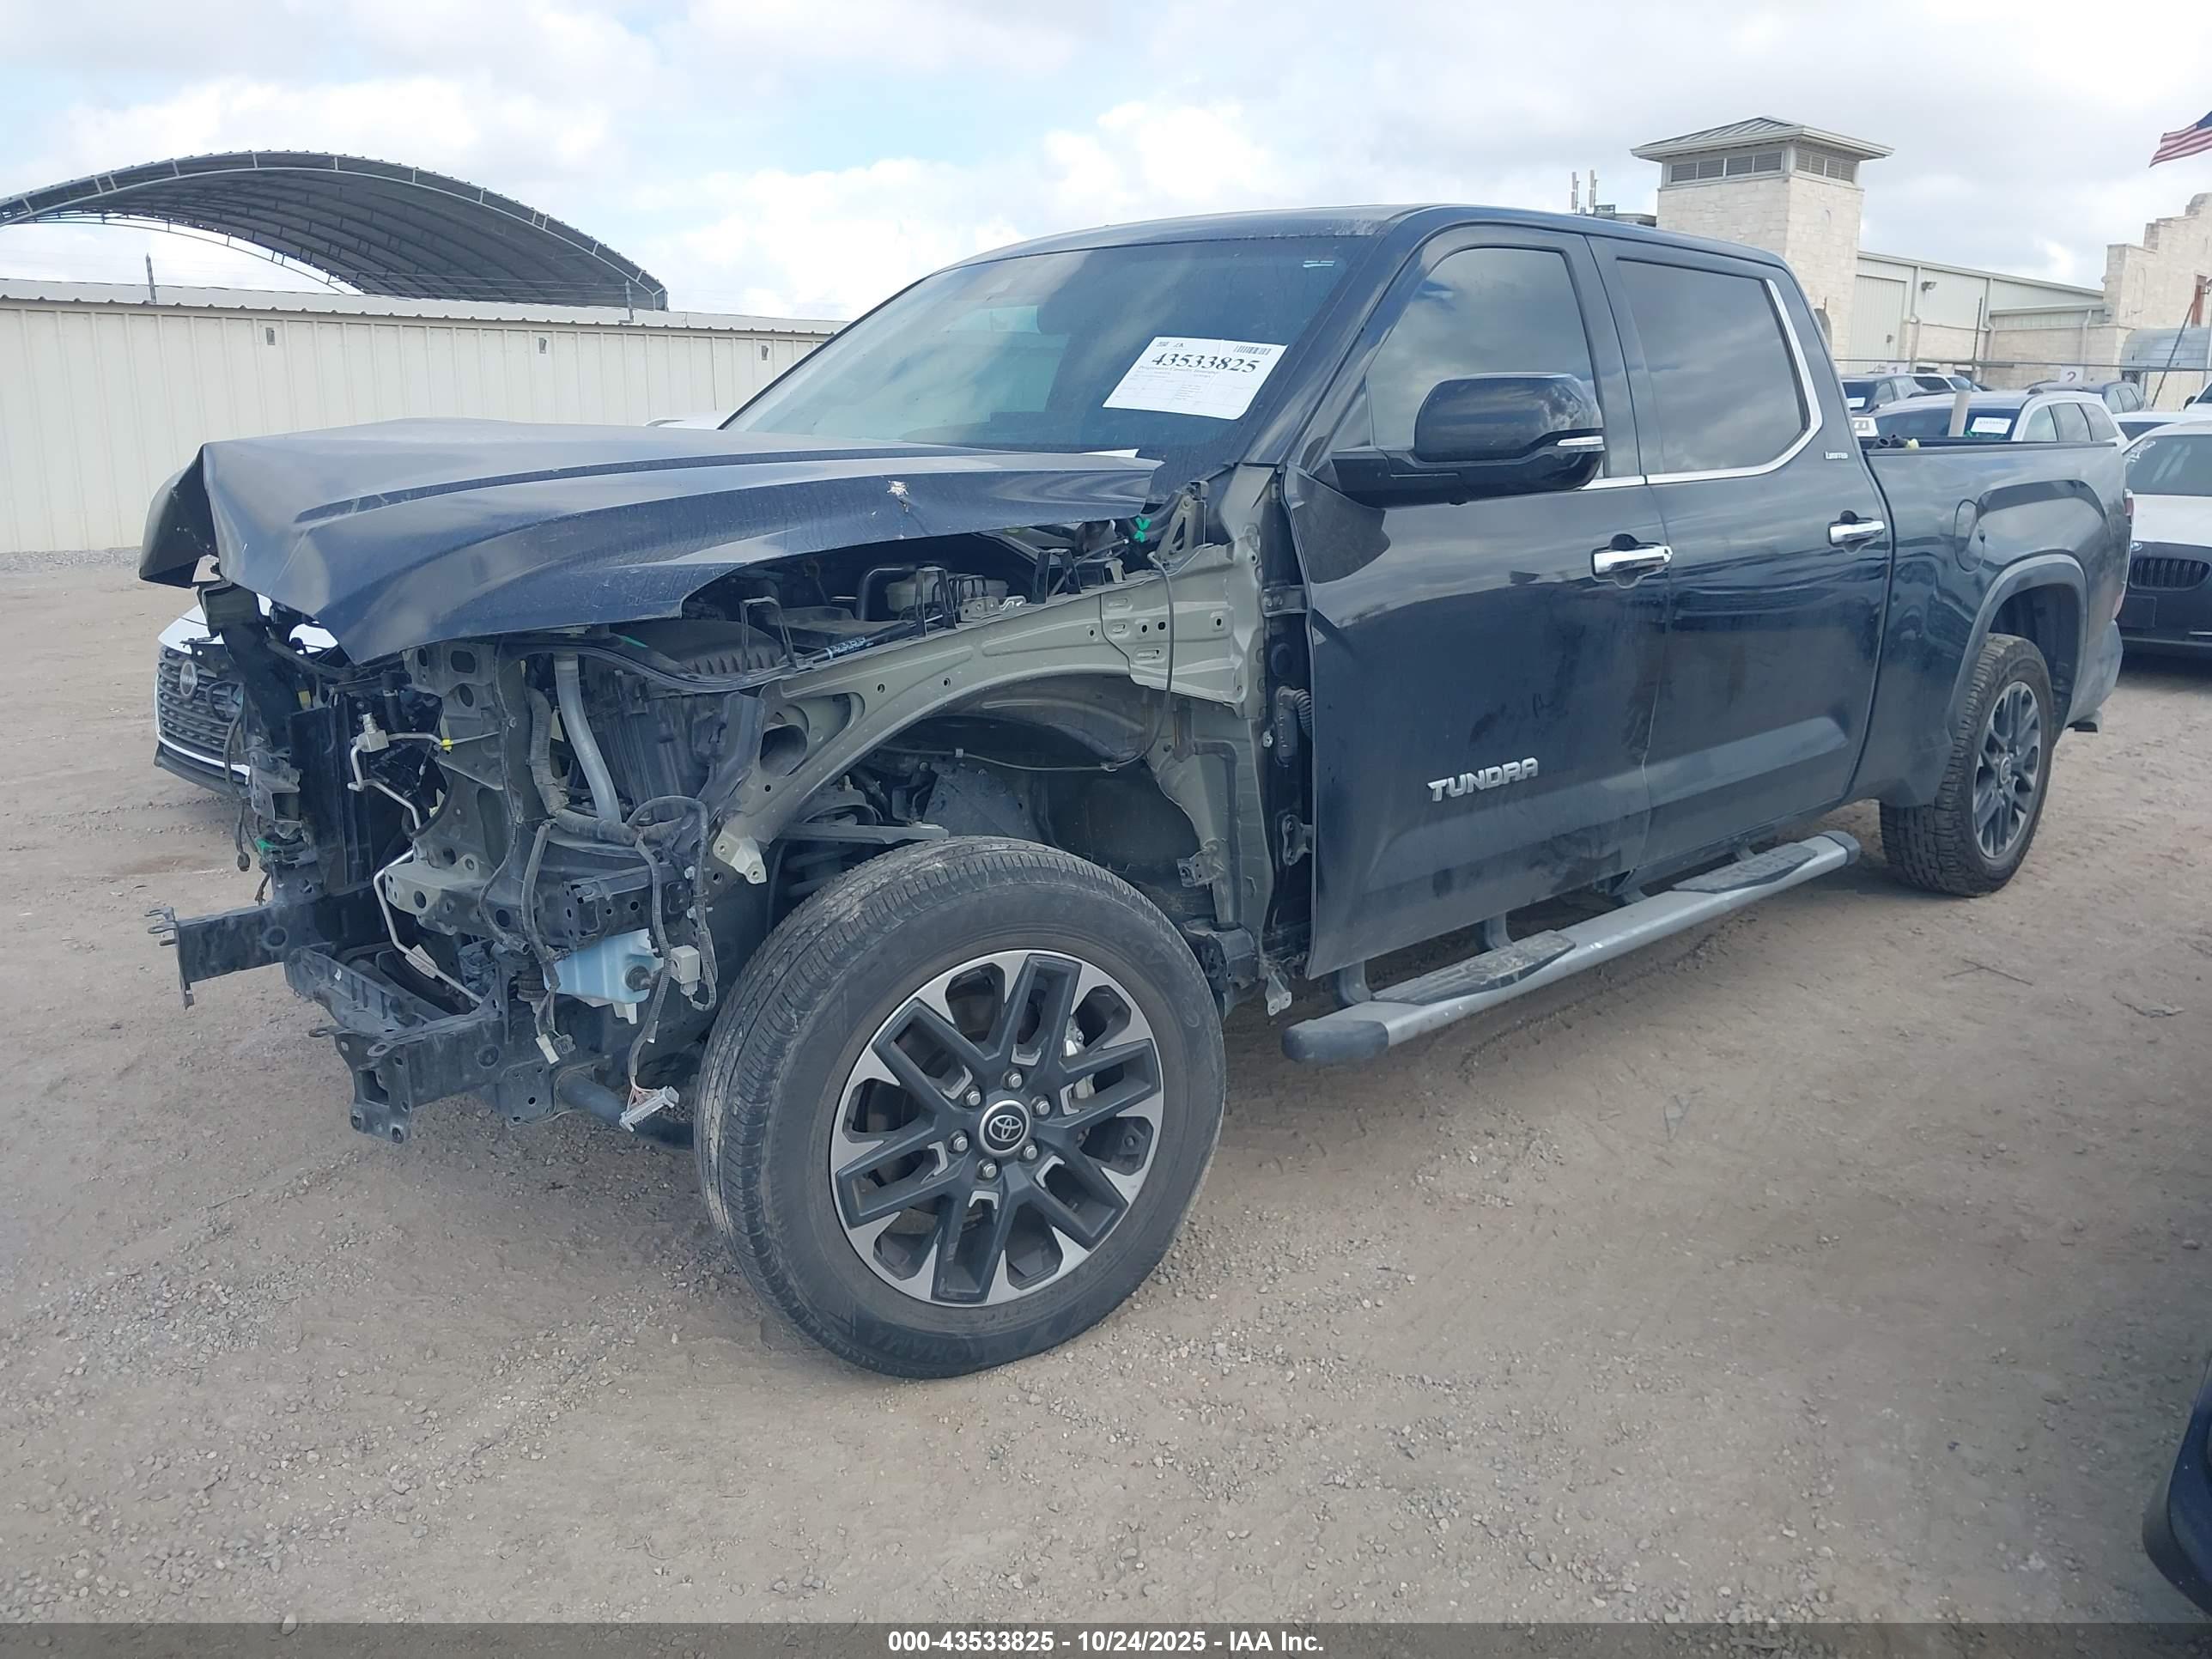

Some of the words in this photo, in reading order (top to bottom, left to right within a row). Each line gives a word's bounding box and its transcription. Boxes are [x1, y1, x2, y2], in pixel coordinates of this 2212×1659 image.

[1152, 352, 1261, 374] 43533825
[2067, 371, 2076, 383] 2
[1427, 757, 1539, 802] TUNDRA
